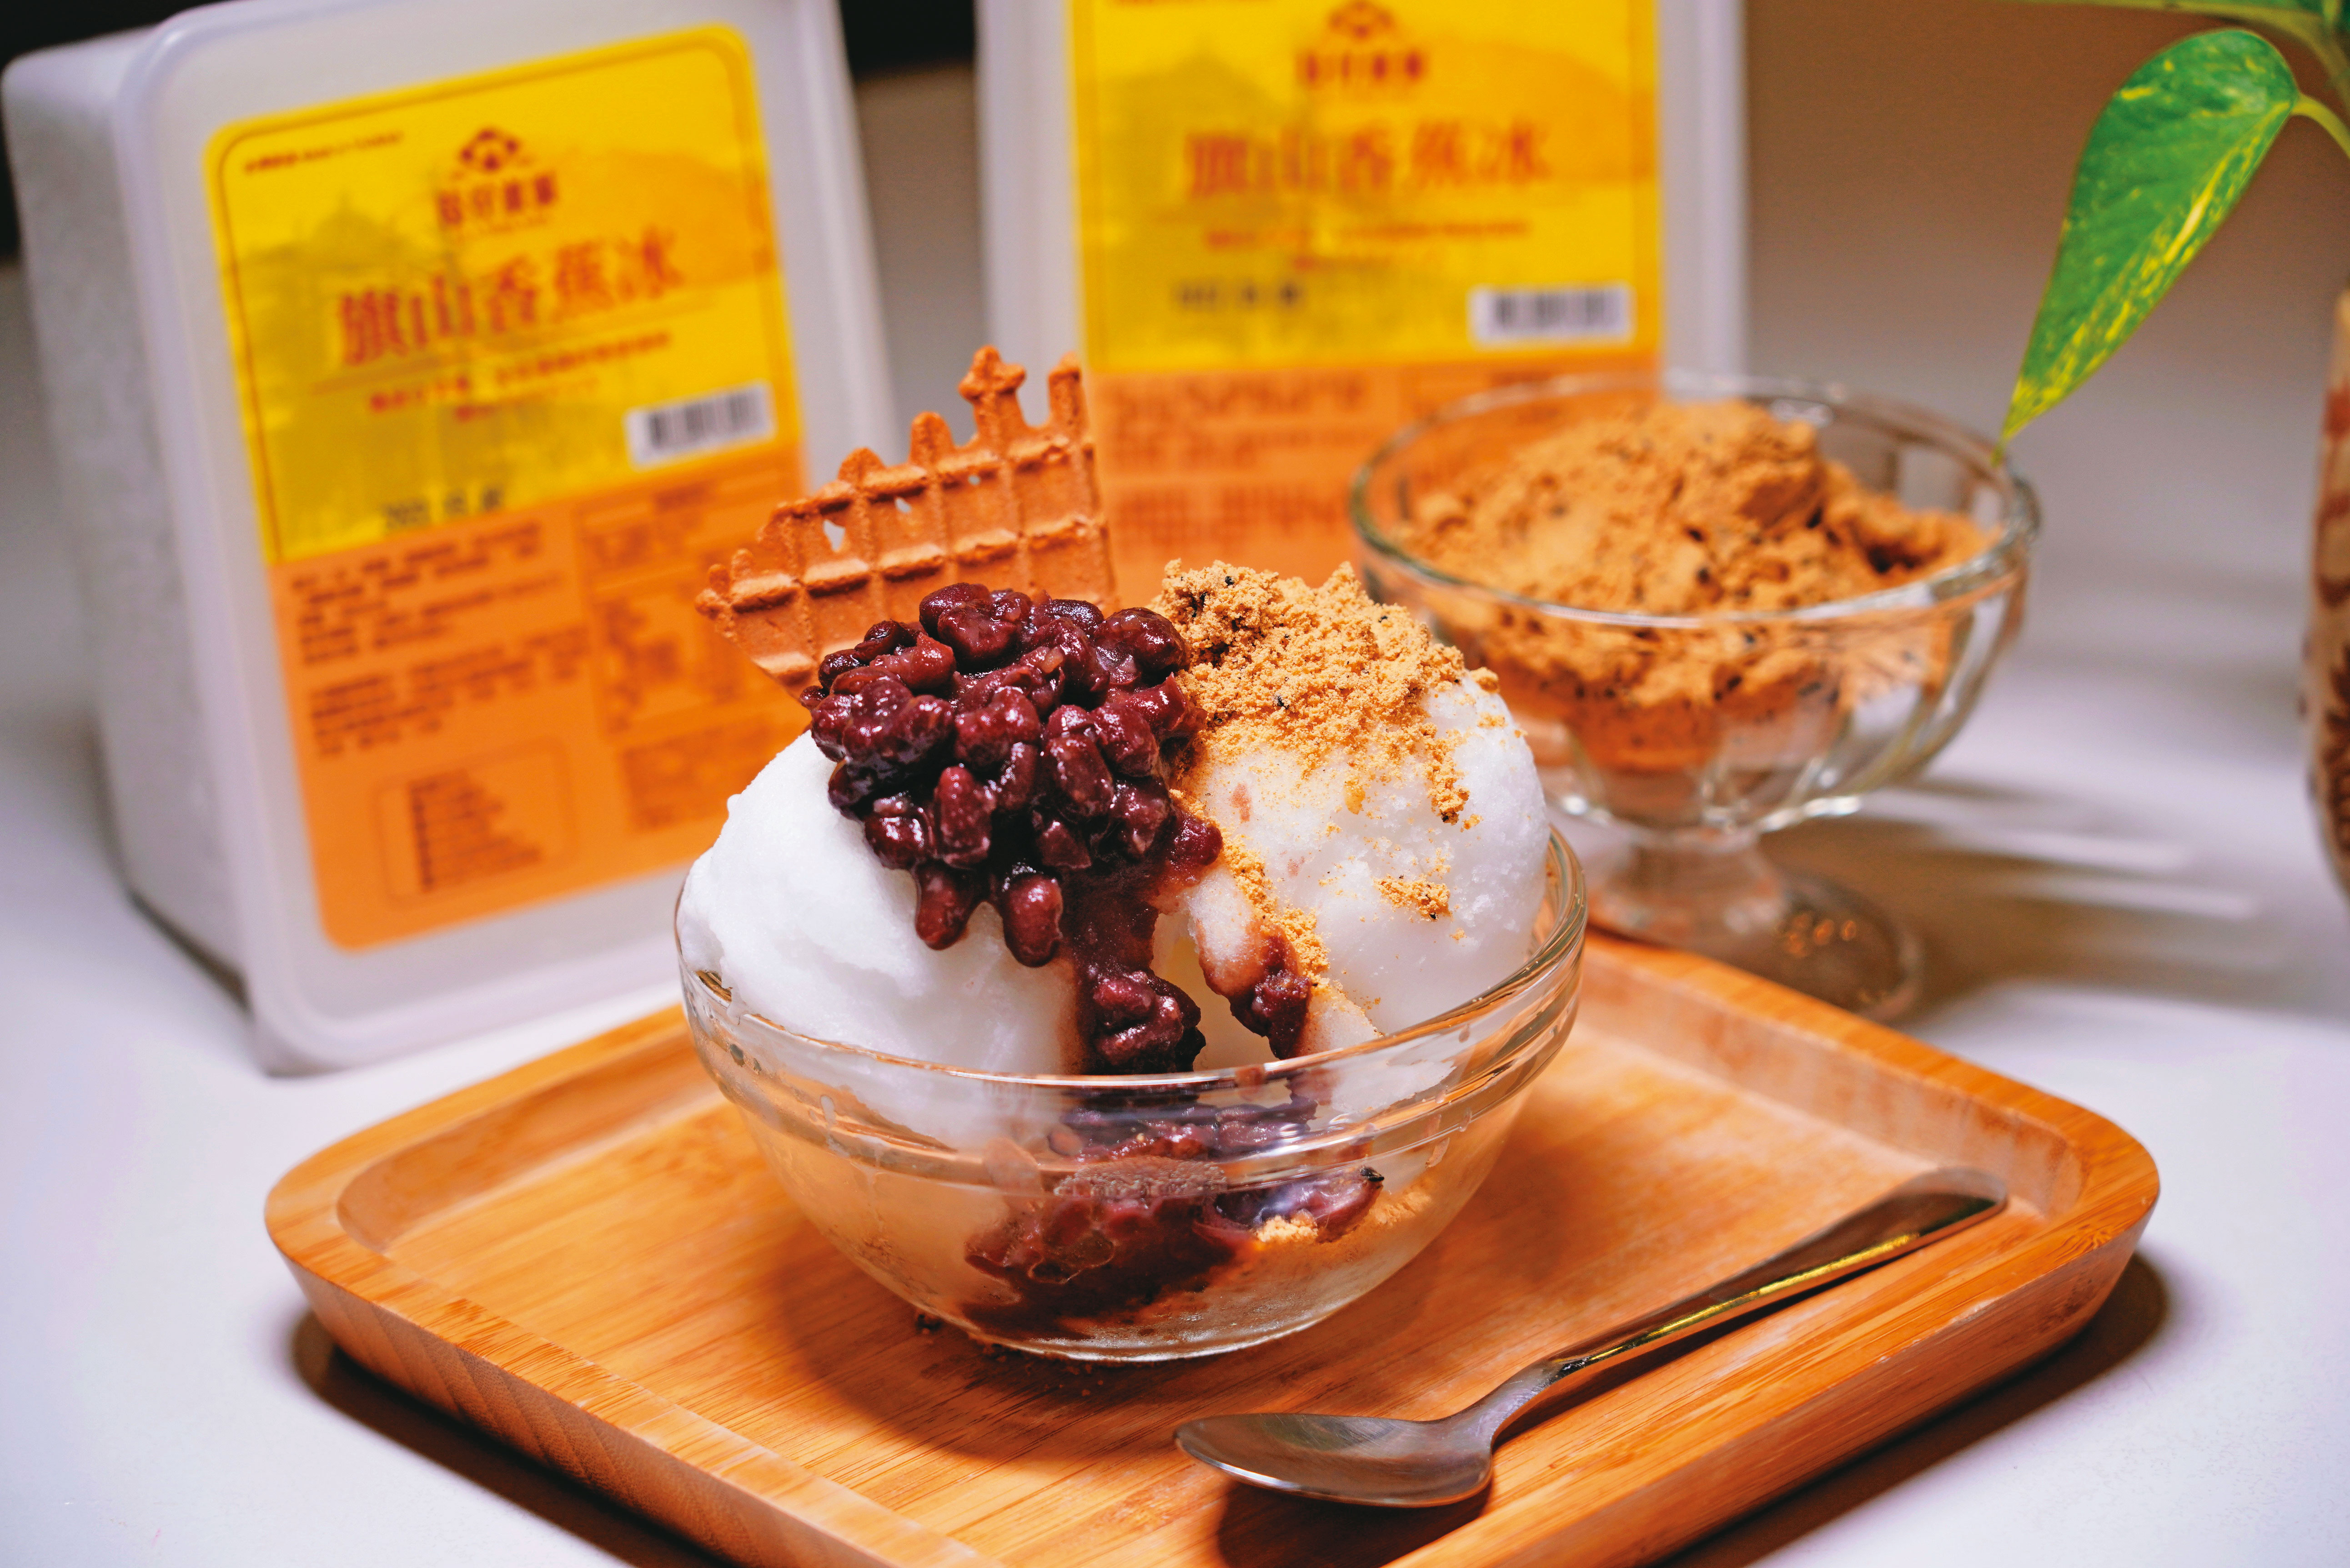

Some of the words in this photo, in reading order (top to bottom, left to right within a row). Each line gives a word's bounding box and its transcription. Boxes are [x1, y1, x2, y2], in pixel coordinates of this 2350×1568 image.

[339, 225, 683, 367] 旗山香蕉冰
